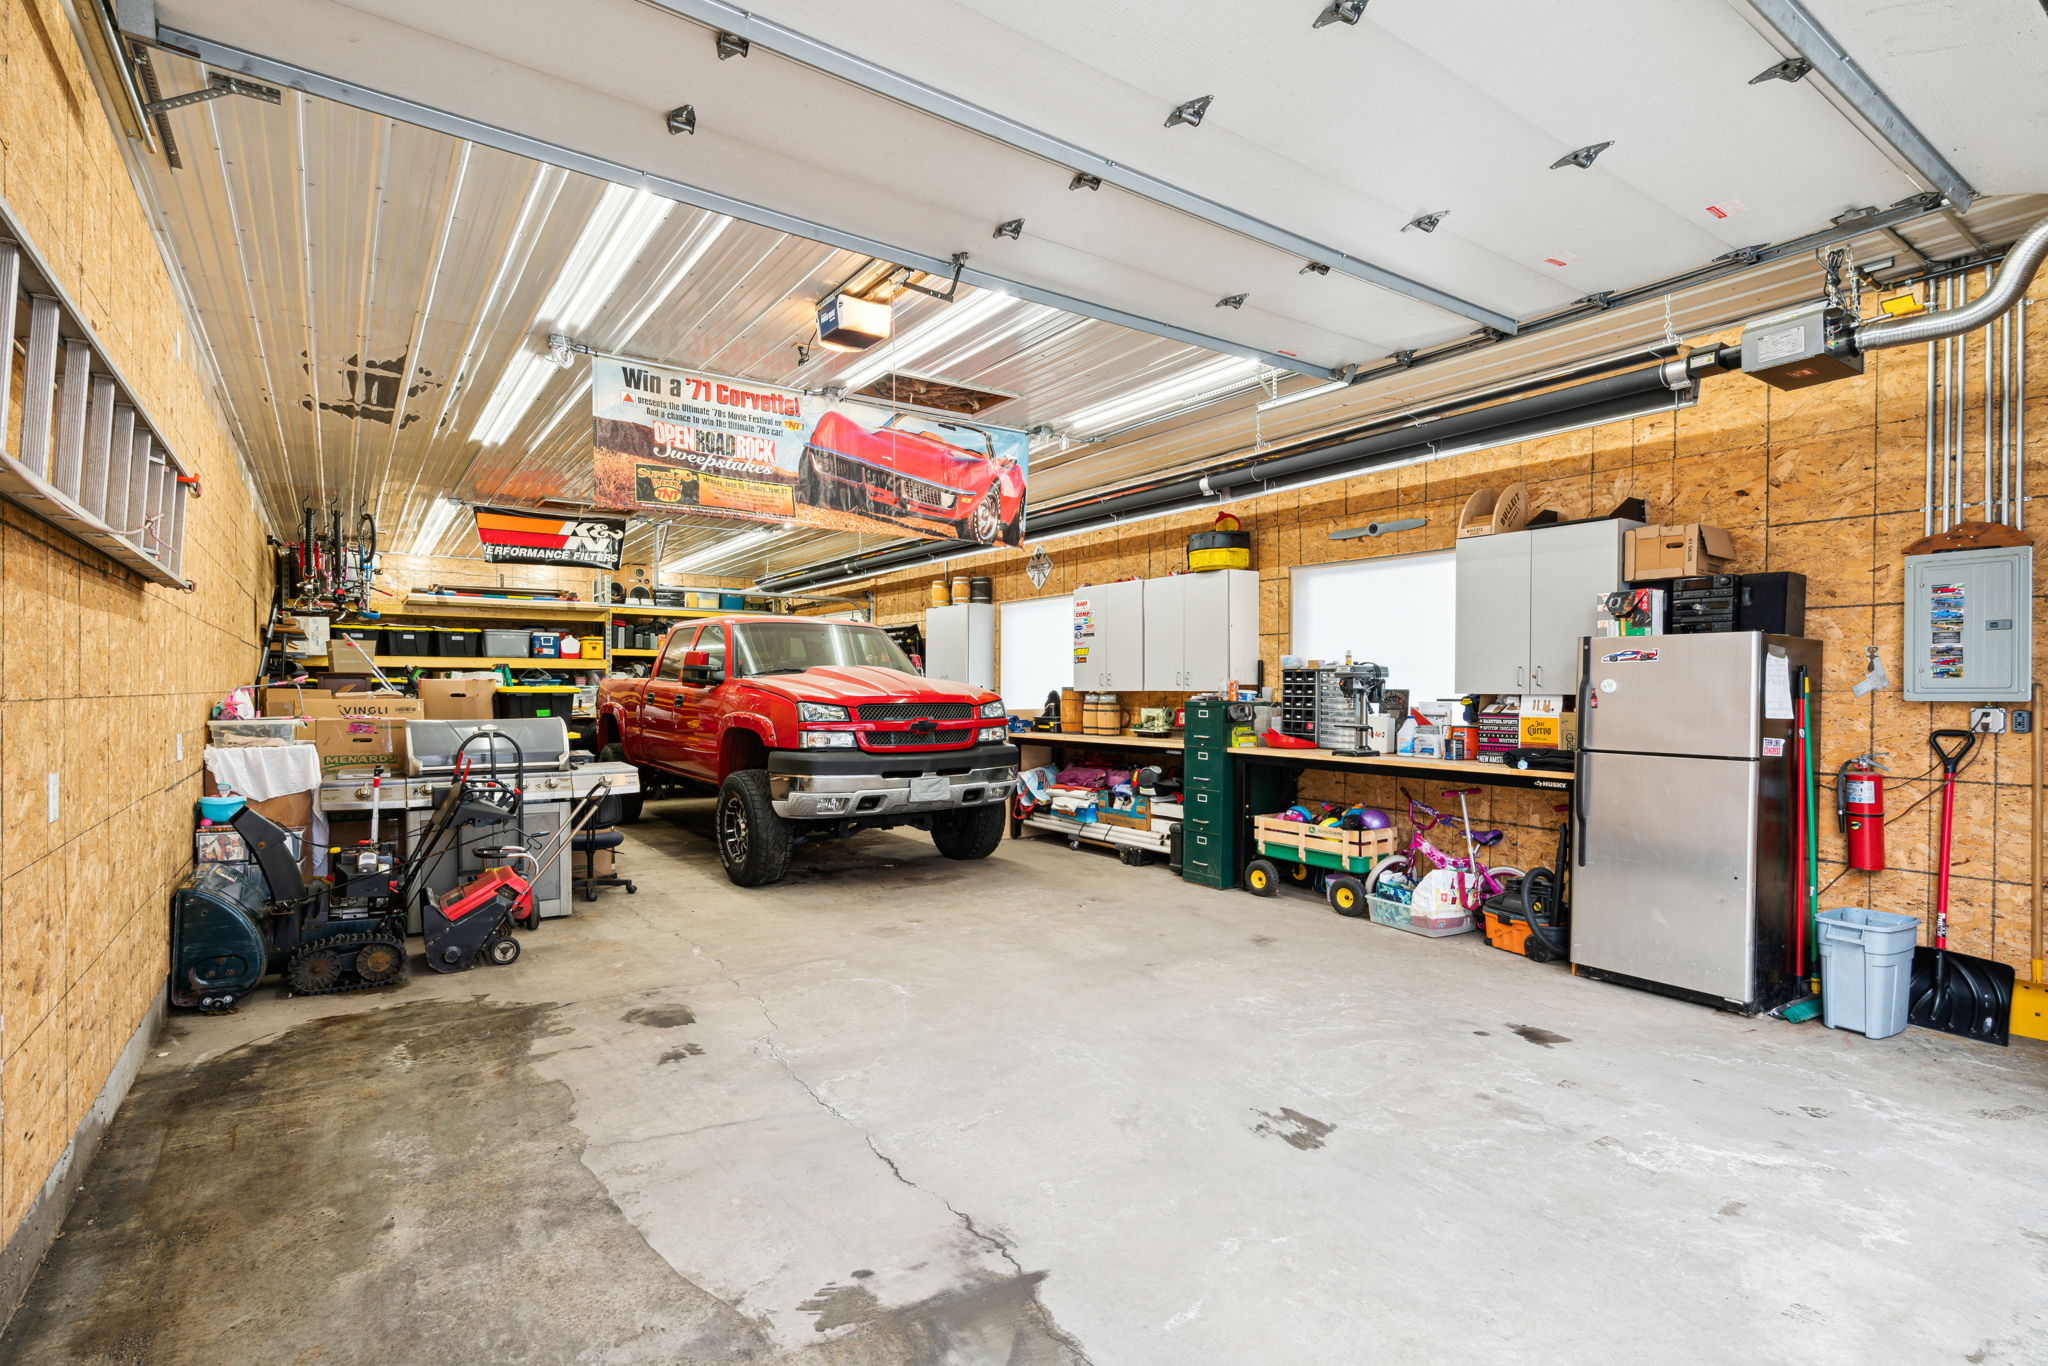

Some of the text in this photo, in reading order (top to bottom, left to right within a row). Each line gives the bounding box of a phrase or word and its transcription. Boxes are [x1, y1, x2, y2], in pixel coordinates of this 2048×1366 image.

[622, 367, 801, 417] Win a '71 Corvette!
[637, 397, 667, 411] presents
[669, 400, 680, 411] the
[682, 402, 710, 416] Ultimate
[728, 410, 747, 422] Movie
[748, 414, 774, 426] Festival
[774, 419, 782, 427] on
[646, 407, 659, 417] And
[661, 411, 666, 419] a
[667, 411, 691, 423] chance
[693, 414, 700, 424] to
[701, 417, 715, 426] win
[716, 418, 727, 428] the
[728, 420, 755, 433] Ultimate
[771, 428, 784, 438] car!
[653, 439, 775, 475] Sweepstakes
[655, 488, 681, 501] TNT
[1500, 492, 1520, 526] BULLEIT
[573, 551, 619, 563] FILTERS
[343, 706, 388, 715] VINGLI
[323, 754, 398, 766] MENARDS
